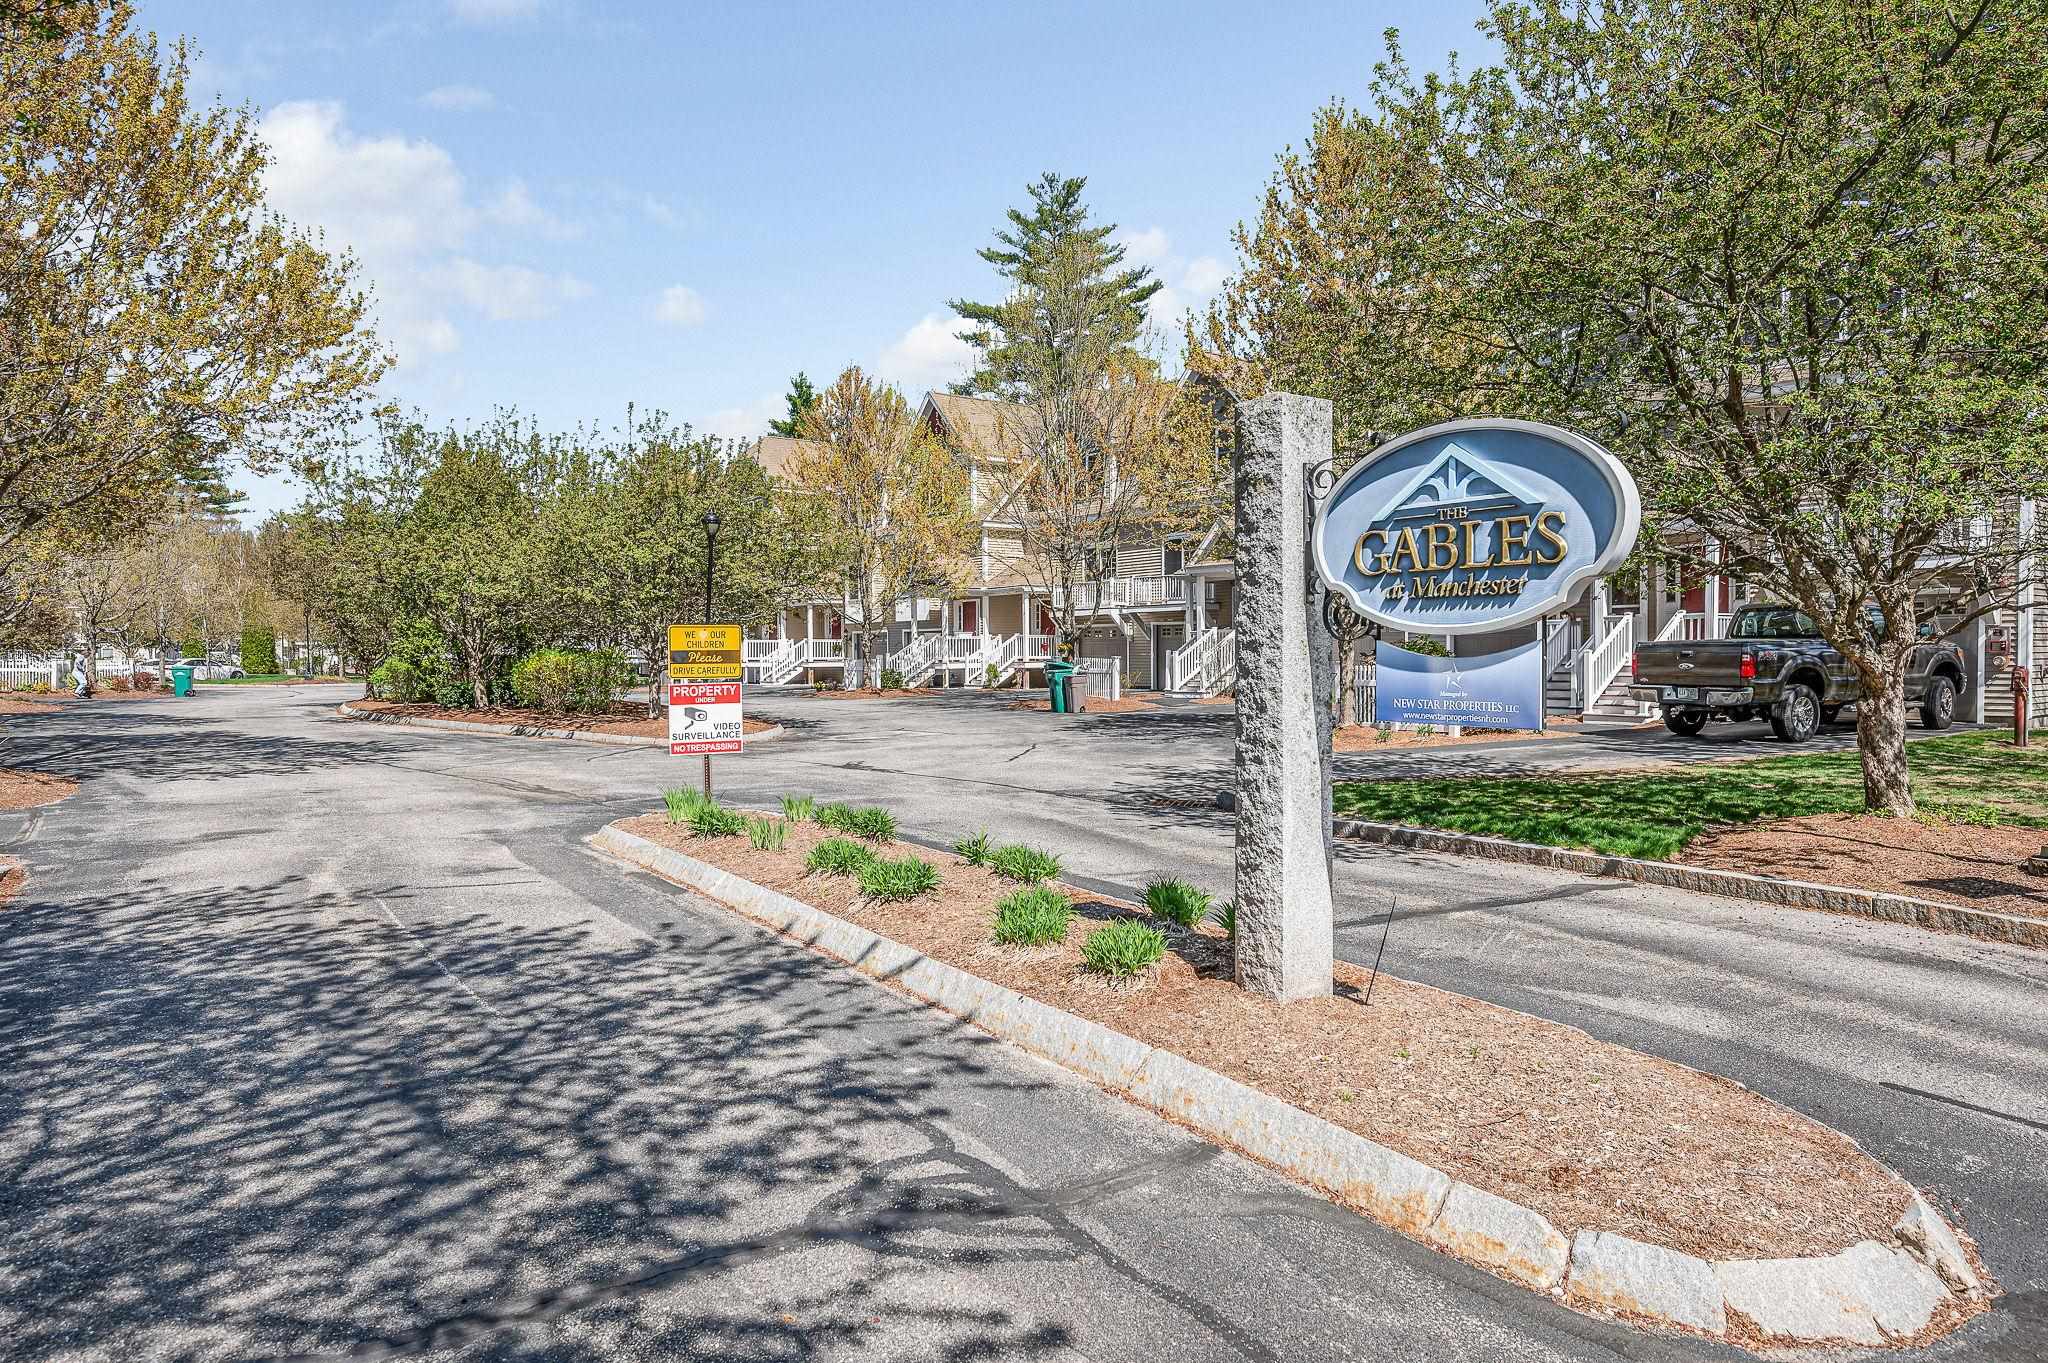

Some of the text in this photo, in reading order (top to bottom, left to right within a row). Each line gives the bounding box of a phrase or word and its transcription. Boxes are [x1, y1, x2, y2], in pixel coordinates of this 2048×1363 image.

[1437, 505, 1469, 521] THE
[1353, 511, 1569, 577] GABLES
[1381, 572, 1528, 600] at Manchester
[685, 631, 726, 639] WE OUR
[686, 640, 725, 648] CHILDREN
[688, 651, 724, 663] Please
[673, 666, 737, 675] DRIVE CAREFULLY
[672, 685, 737, 697] PROPERTY
[1393, 698, 1520, 713] NEW STAR PROPERTIES LLC
[1402, 712, 1509, 724] www.newstarpropertiesnh.com
[713, 721, 741, 730] VIDEO
[672, 731, 741, 741] SURVEILLANCE
[673, 742, 739, 753] NO TRESPASSING
